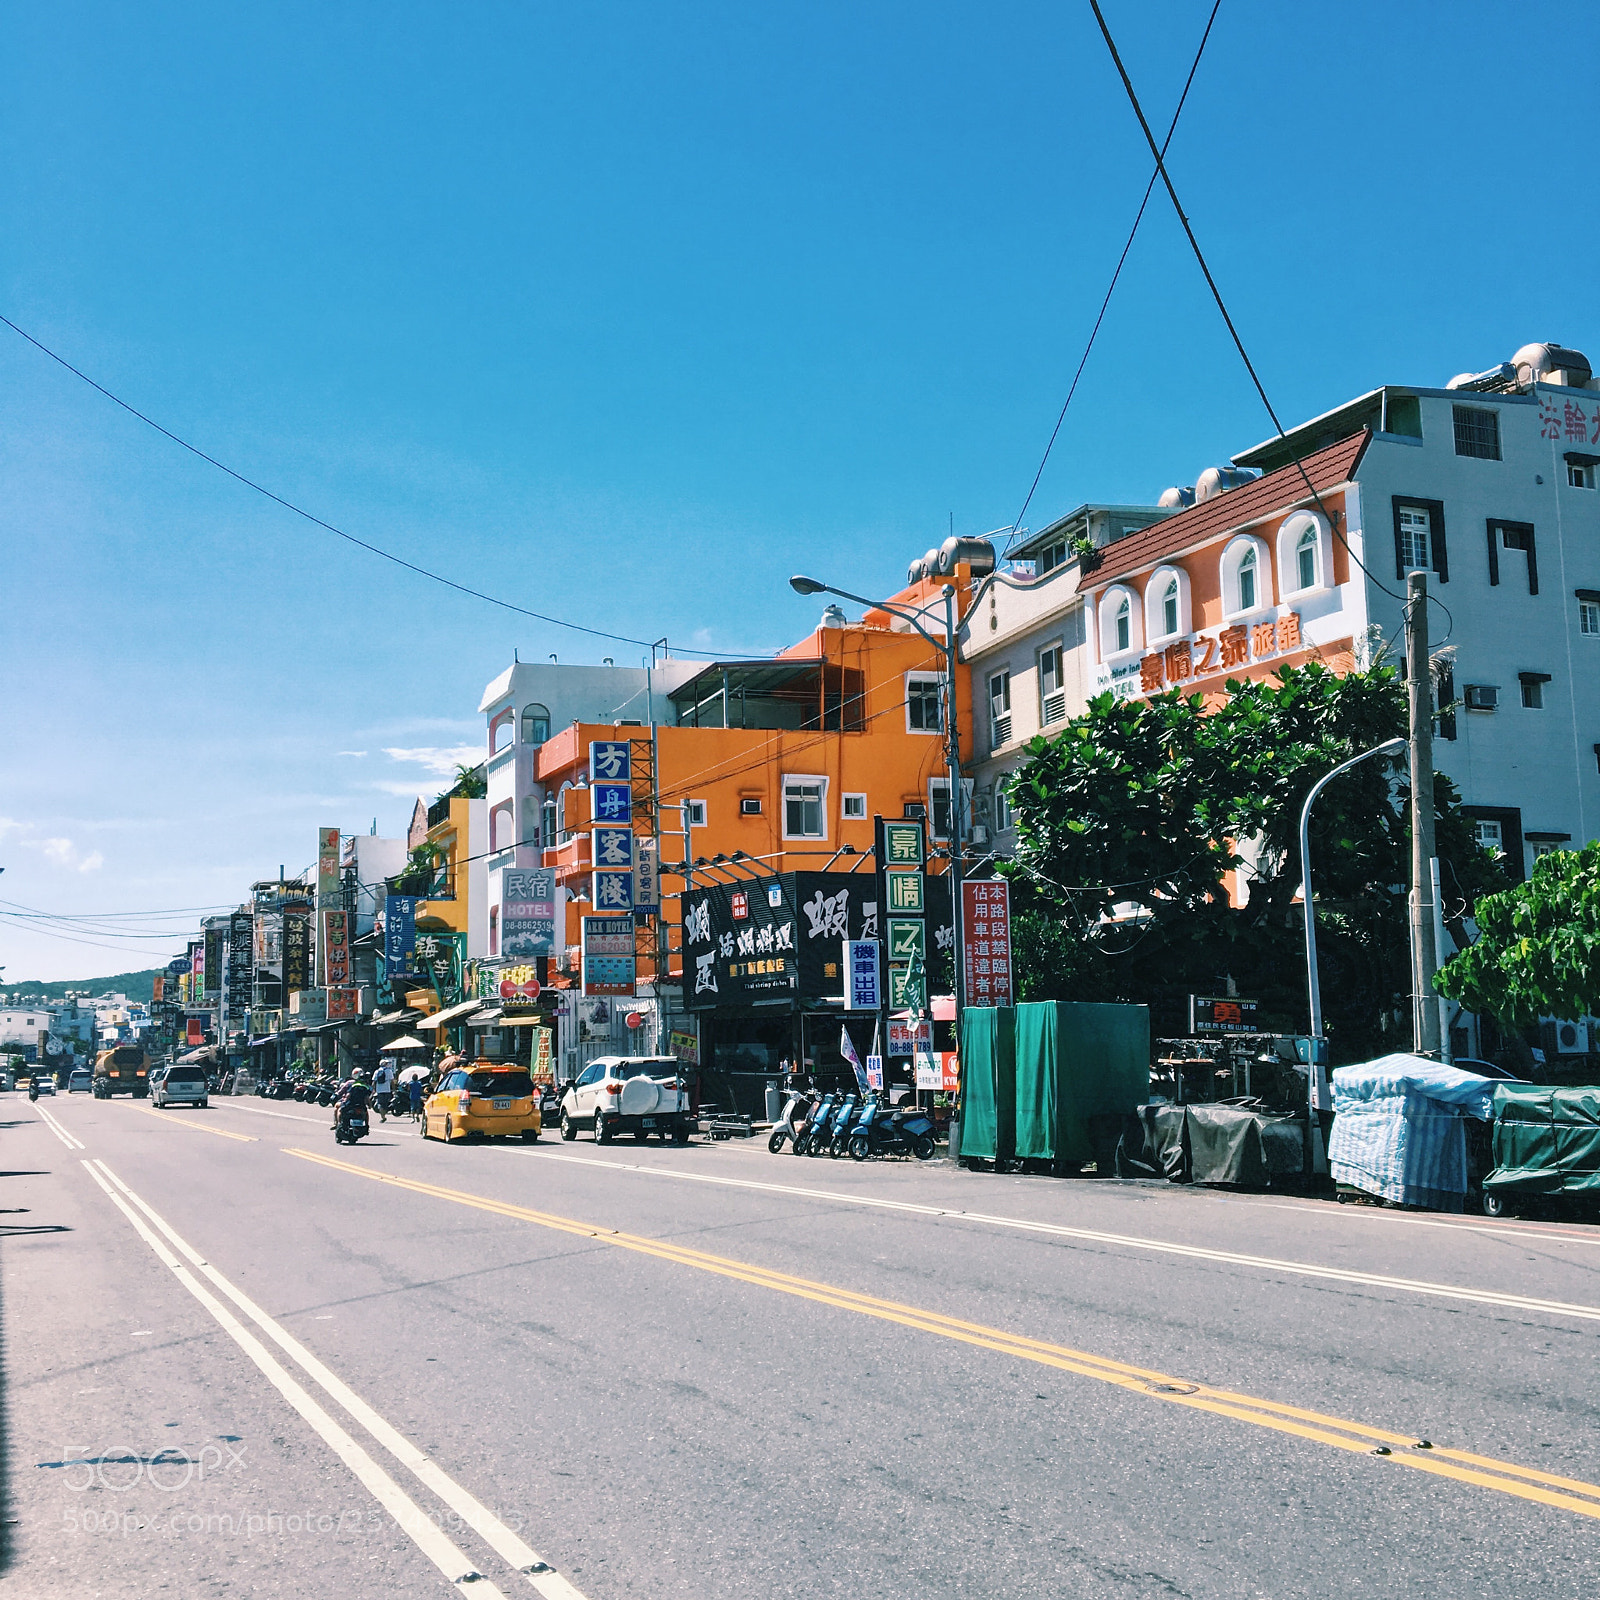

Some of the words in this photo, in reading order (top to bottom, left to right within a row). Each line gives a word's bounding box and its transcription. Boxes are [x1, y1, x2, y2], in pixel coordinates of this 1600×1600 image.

[596, 744, 631, 907] 方舟客棧
[507, 873, 550, 899] 民宿
[507, 904, 550, 916] HOTEL
[505, 921, 552, 930] 08-8862519
[587, 921, 604, 933] ARK
[605, 921, 632, 933] HOTEL
[853, 944, 877, 1005] 機車出租
[890, 1041, 931, 1053] 08-886789
